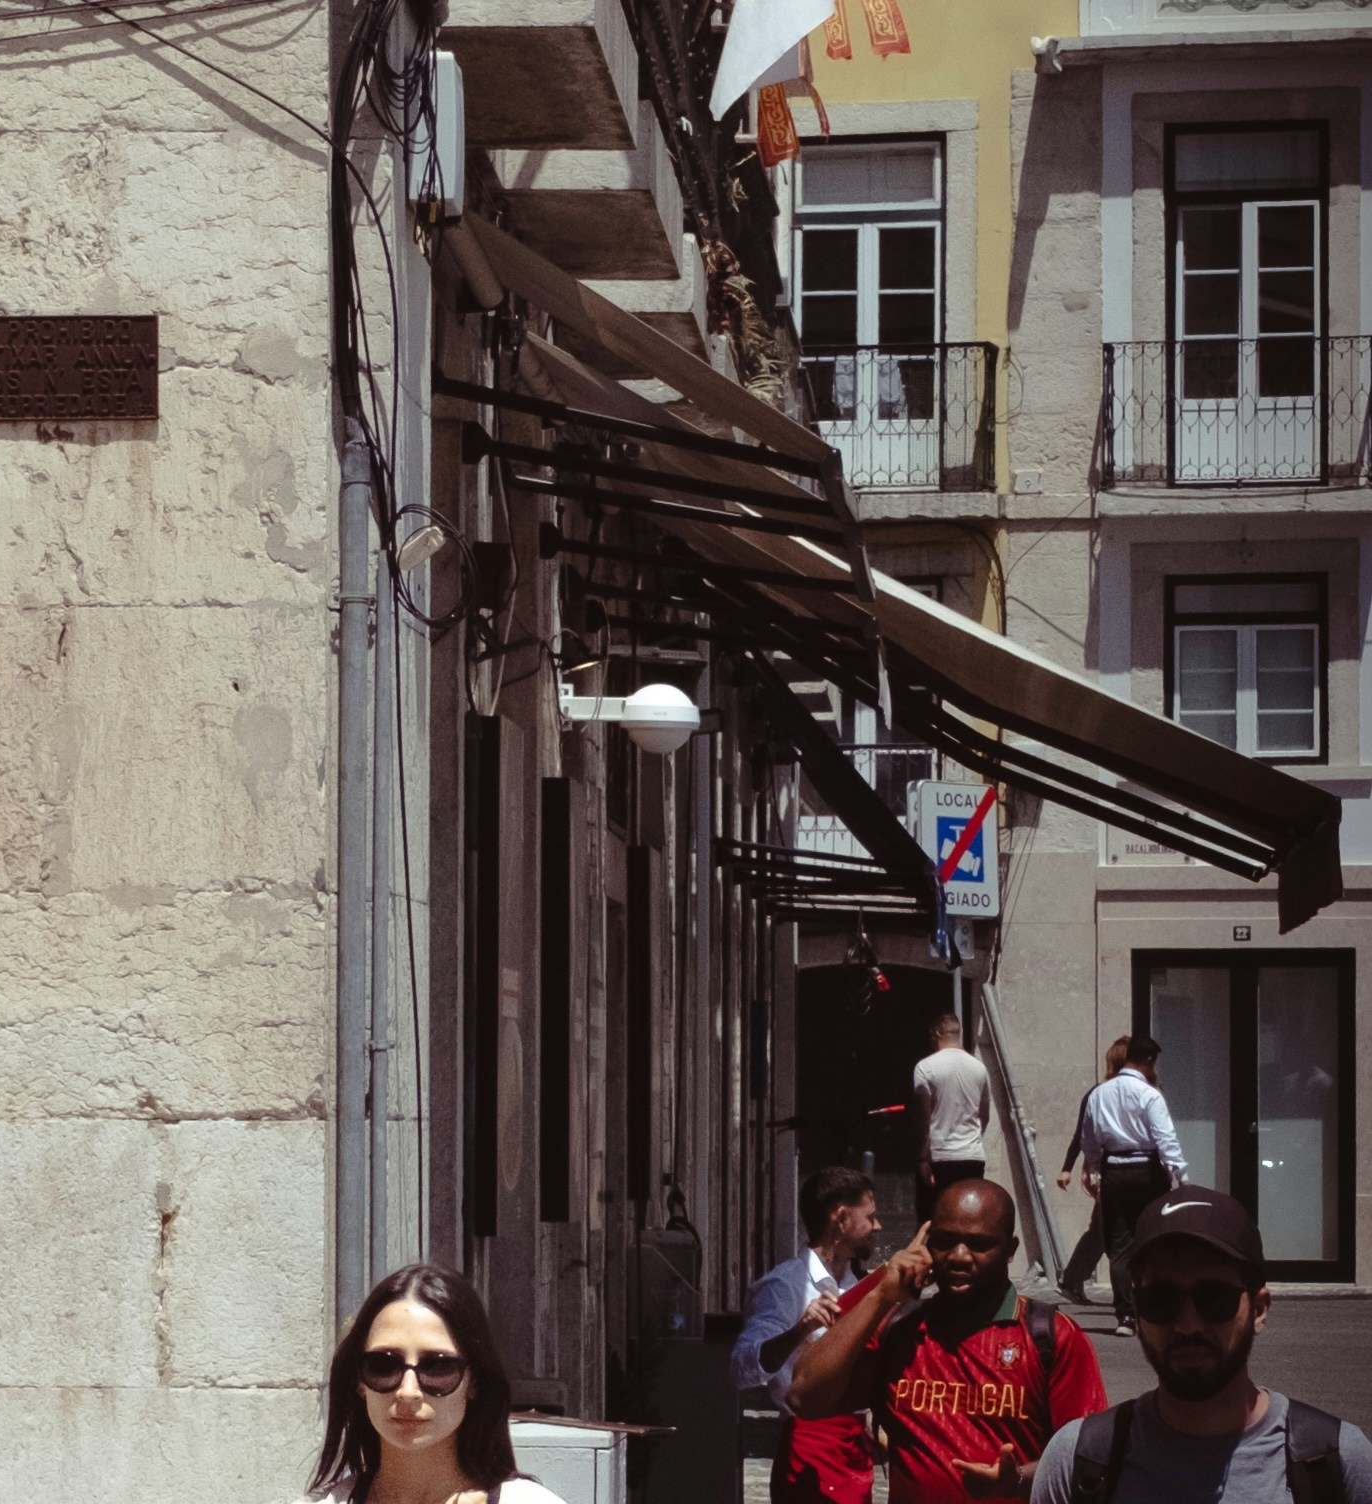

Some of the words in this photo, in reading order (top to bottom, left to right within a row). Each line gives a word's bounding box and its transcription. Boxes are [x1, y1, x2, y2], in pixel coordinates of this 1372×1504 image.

[936, 792, 980, 808] LOCAL
[945, 891, 990, 908] GIADO
[895, 1379, 1029, 1419] PORTUGAL
